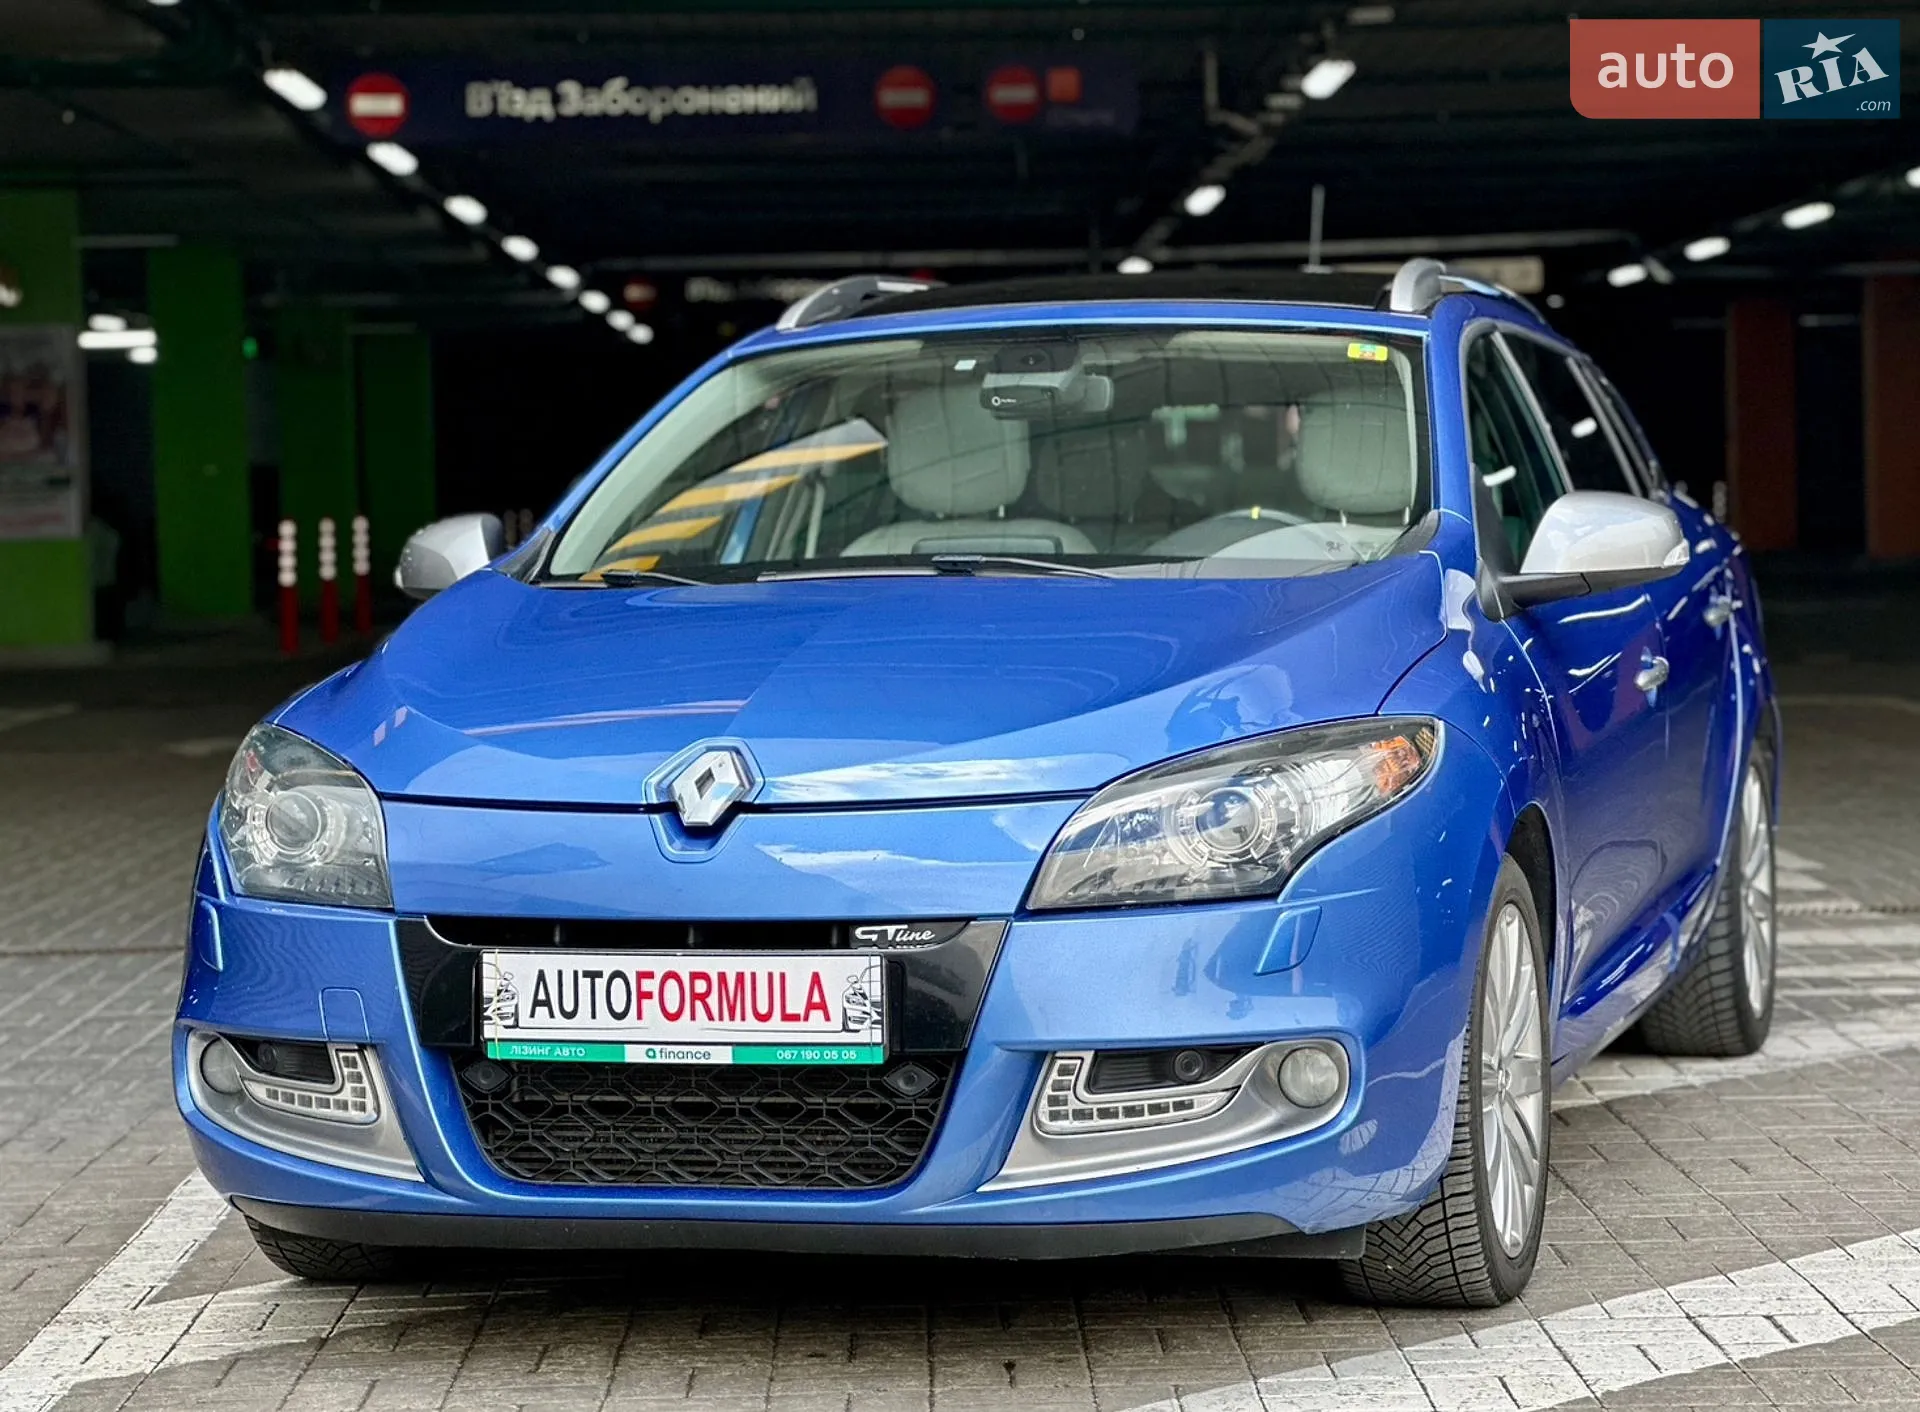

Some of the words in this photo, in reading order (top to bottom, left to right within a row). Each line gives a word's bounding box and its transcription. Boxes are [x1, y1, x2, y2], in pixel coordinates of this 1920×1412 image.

[556, 76, 818, 124] Заборонений
[529, 969, 832, 1022] AUTOFORMULA
[509, 1045, 552, 1056] ЛІЗИНГ
[553, 1046, 586, 1057] АВТО
[659, 1048, 711, 1060] finance
[776, 1049, 798, 1060] 067
[800, 1049, 820, 1060] 190
[823, 1049, 839, 1060] 05
[841, 1050, 857, 1060] 05
